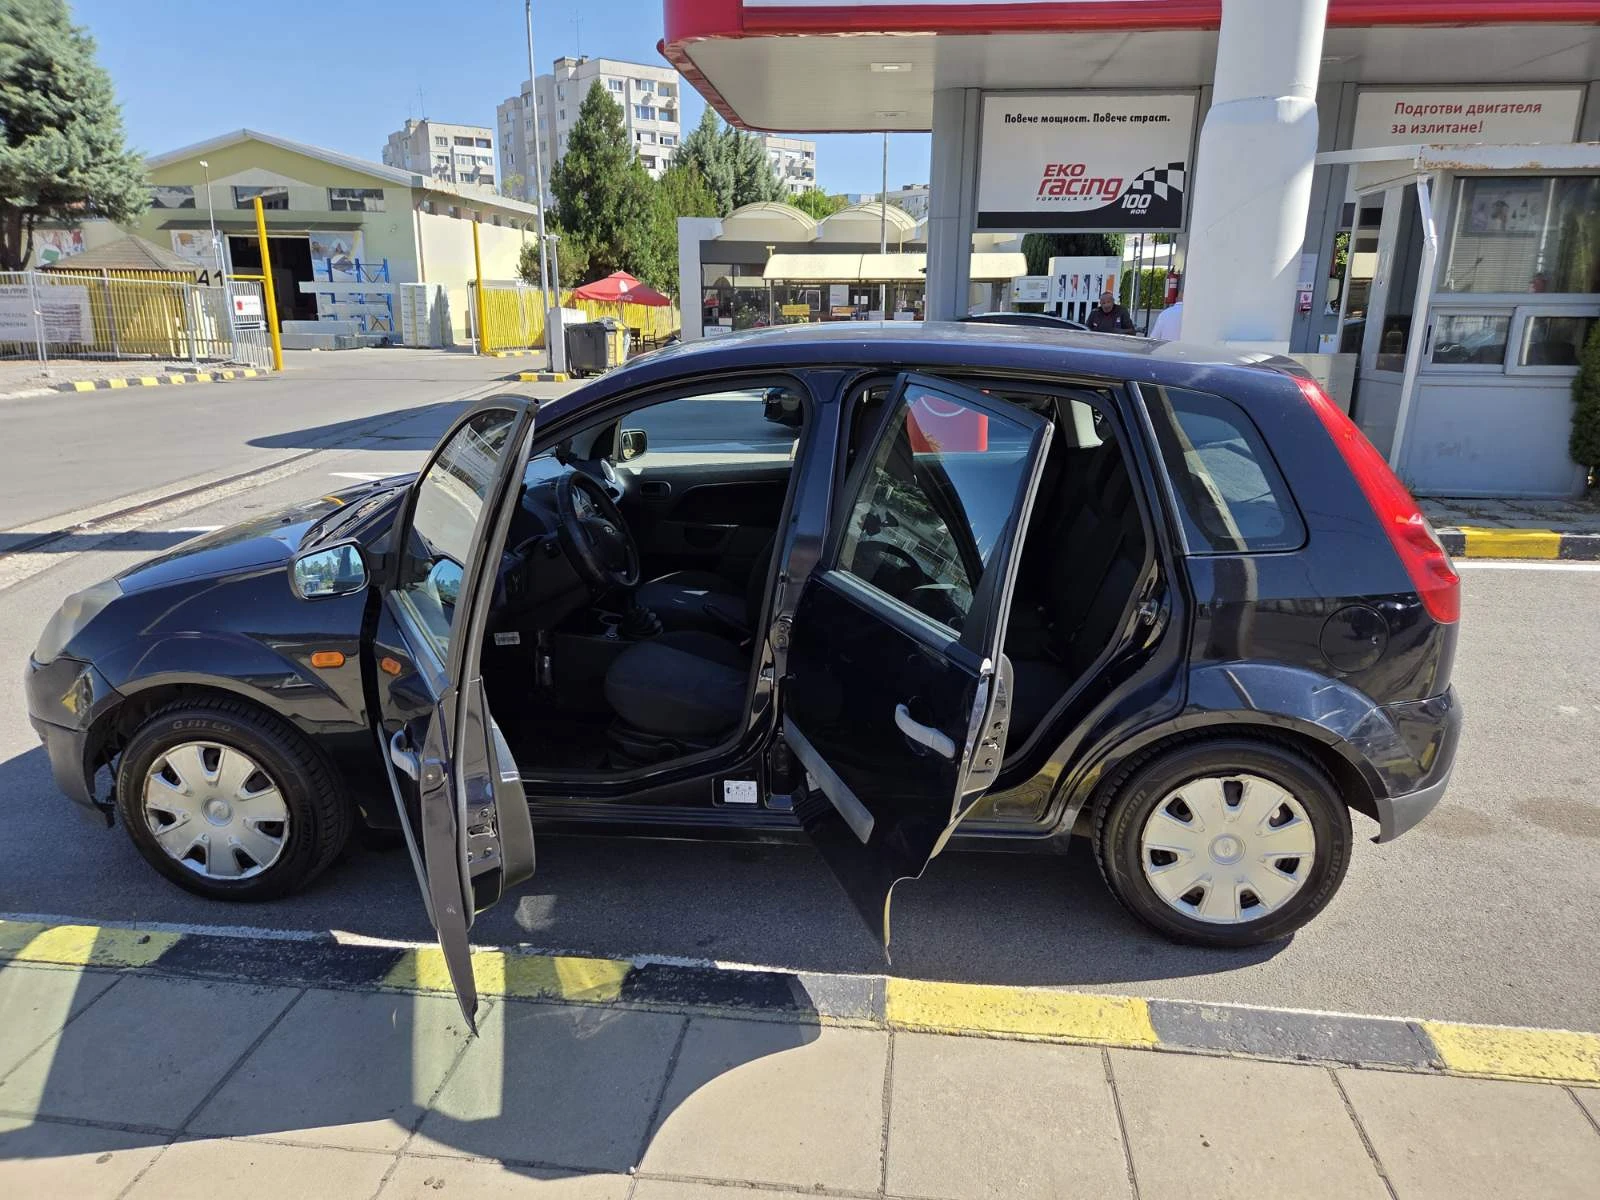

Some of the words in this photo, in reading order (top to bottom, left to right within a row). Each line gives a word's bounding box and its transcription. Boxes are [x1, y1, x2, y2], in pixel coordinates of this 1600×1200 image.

[1395, 102, 1462, 116] Подготви
[1465, 103, 1542, 116] двигателя
[1004, 113, 1038, 123] Повече
[1040, 114, 1090, 124] мощност.
[1092, 113, 1127, 122] Повече
[1129, 114, 1171, 124] страст.
[1391, 123, 1406, 134] за
[1411, 120, 1484, 134] излитане!
[1043, 164, 1086, 177] EKO
[1038, 178, 1123, 201] racing
[1121, 194, 1152, 209] 100
